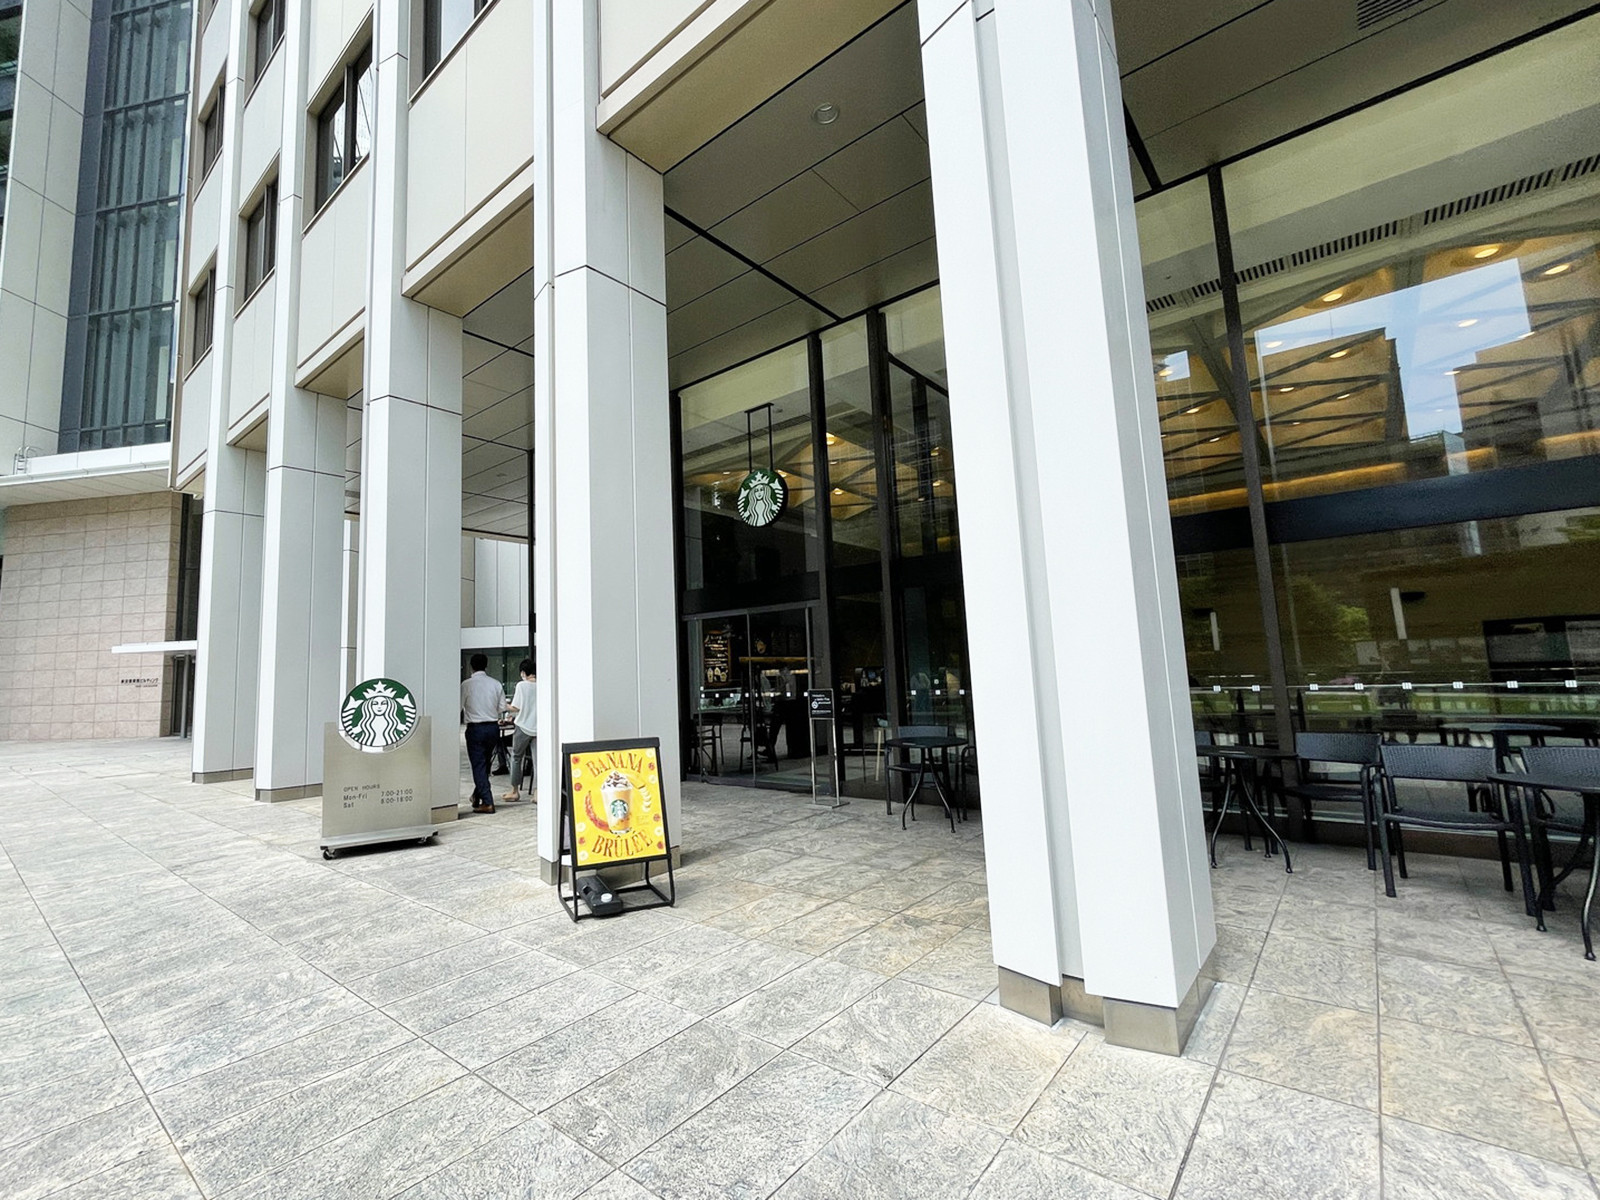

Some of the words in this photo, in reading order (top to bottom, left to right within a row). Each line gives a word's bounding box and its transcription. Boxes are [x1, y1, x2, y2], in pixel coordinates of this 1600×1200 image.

[586, 751, 644, 778] BANANA
[361, 783, 380, 791] HOURS
[343, 793, 368, 801] Mon-Fri
